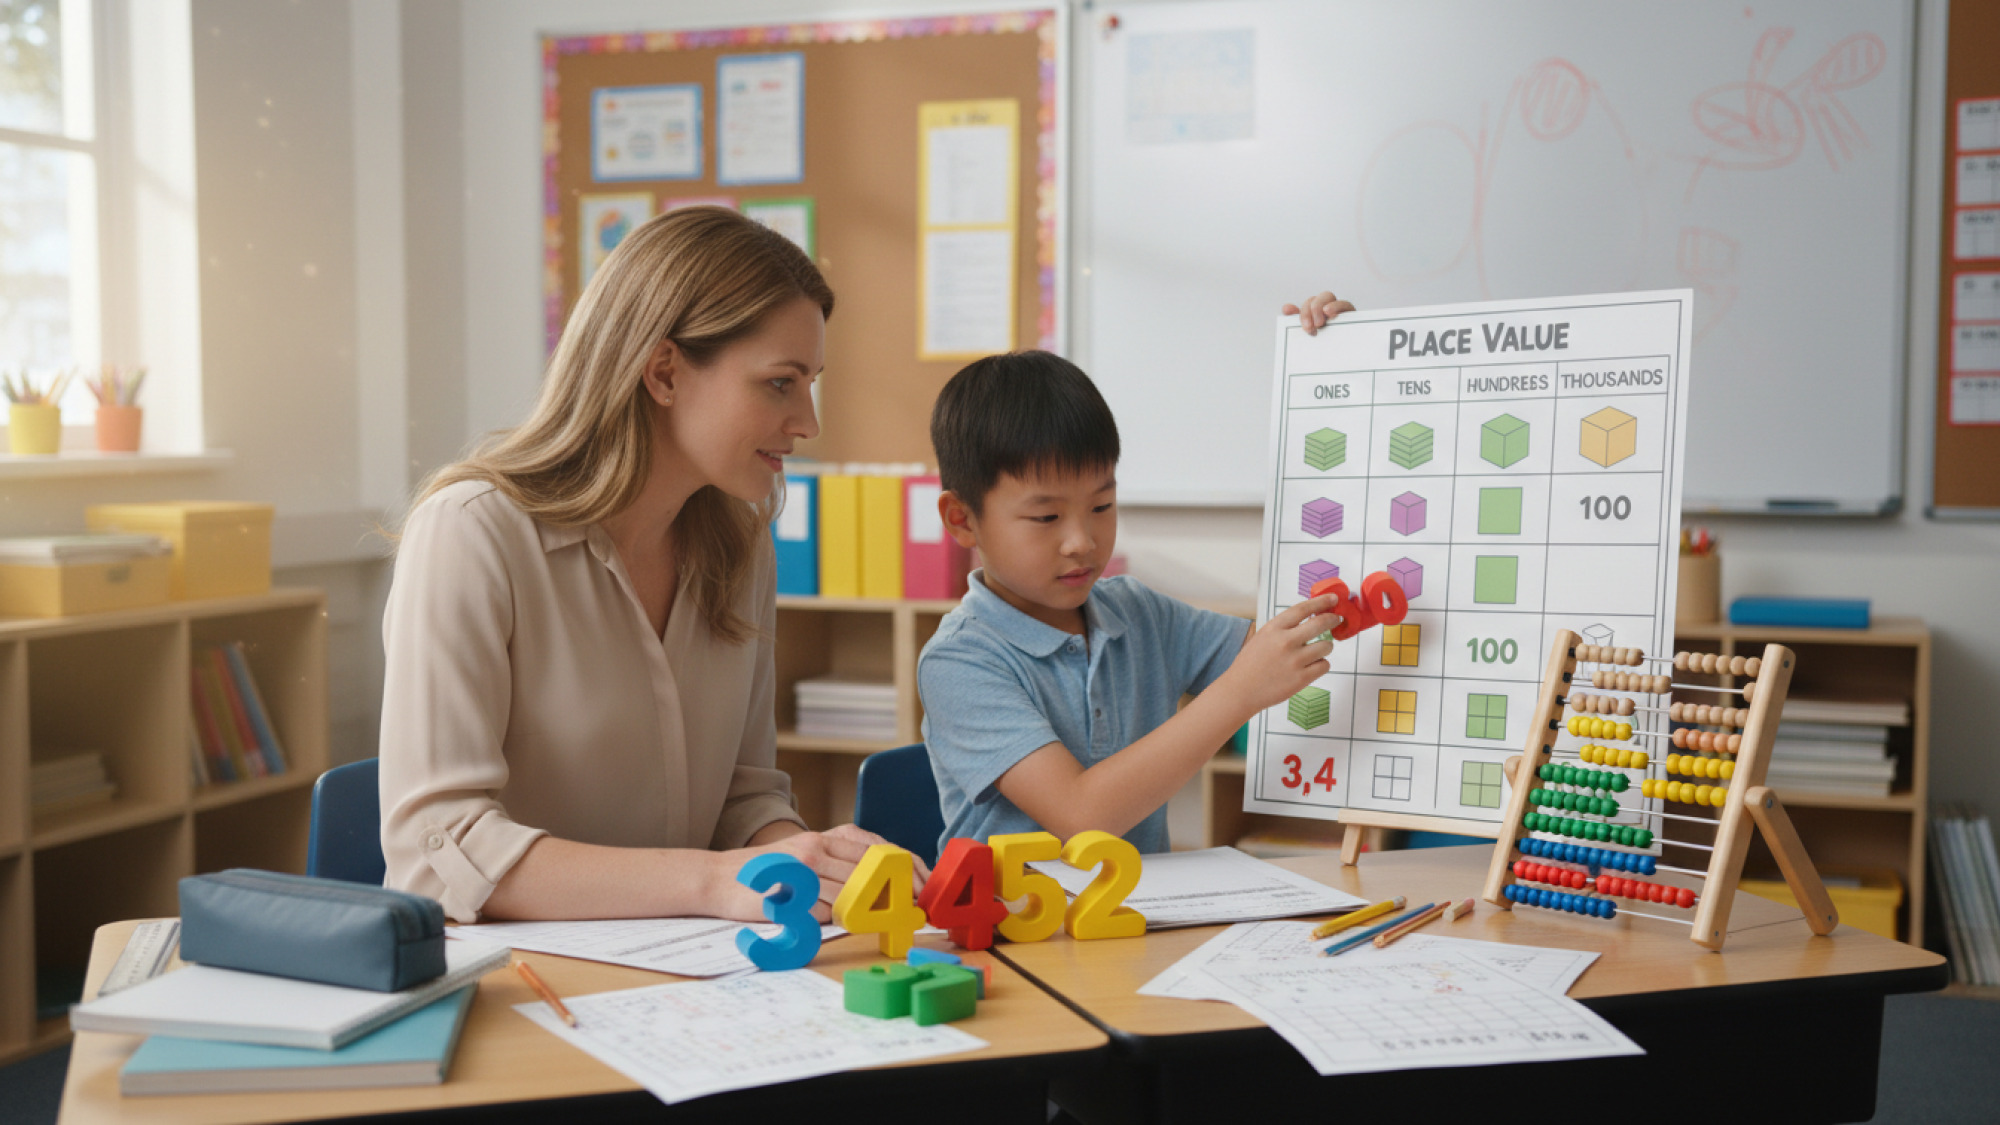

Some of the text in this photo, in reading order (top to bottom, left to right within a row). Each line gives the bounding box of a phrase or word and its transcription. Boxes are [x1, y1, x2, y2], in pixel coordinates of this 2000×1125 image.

[1389, 322, 1570, 360] PLACE VALUE
[1314, 383, 1350, 400] ONES
[1397, 380, 1431, 395] TENS
[1561, 368, 1663, 389] THOUSANDS
[1579, 495, 1632, 521] 100
[1466, 637, 1519, 665] 100
[1281, 753, 1337, 797] 3,4
